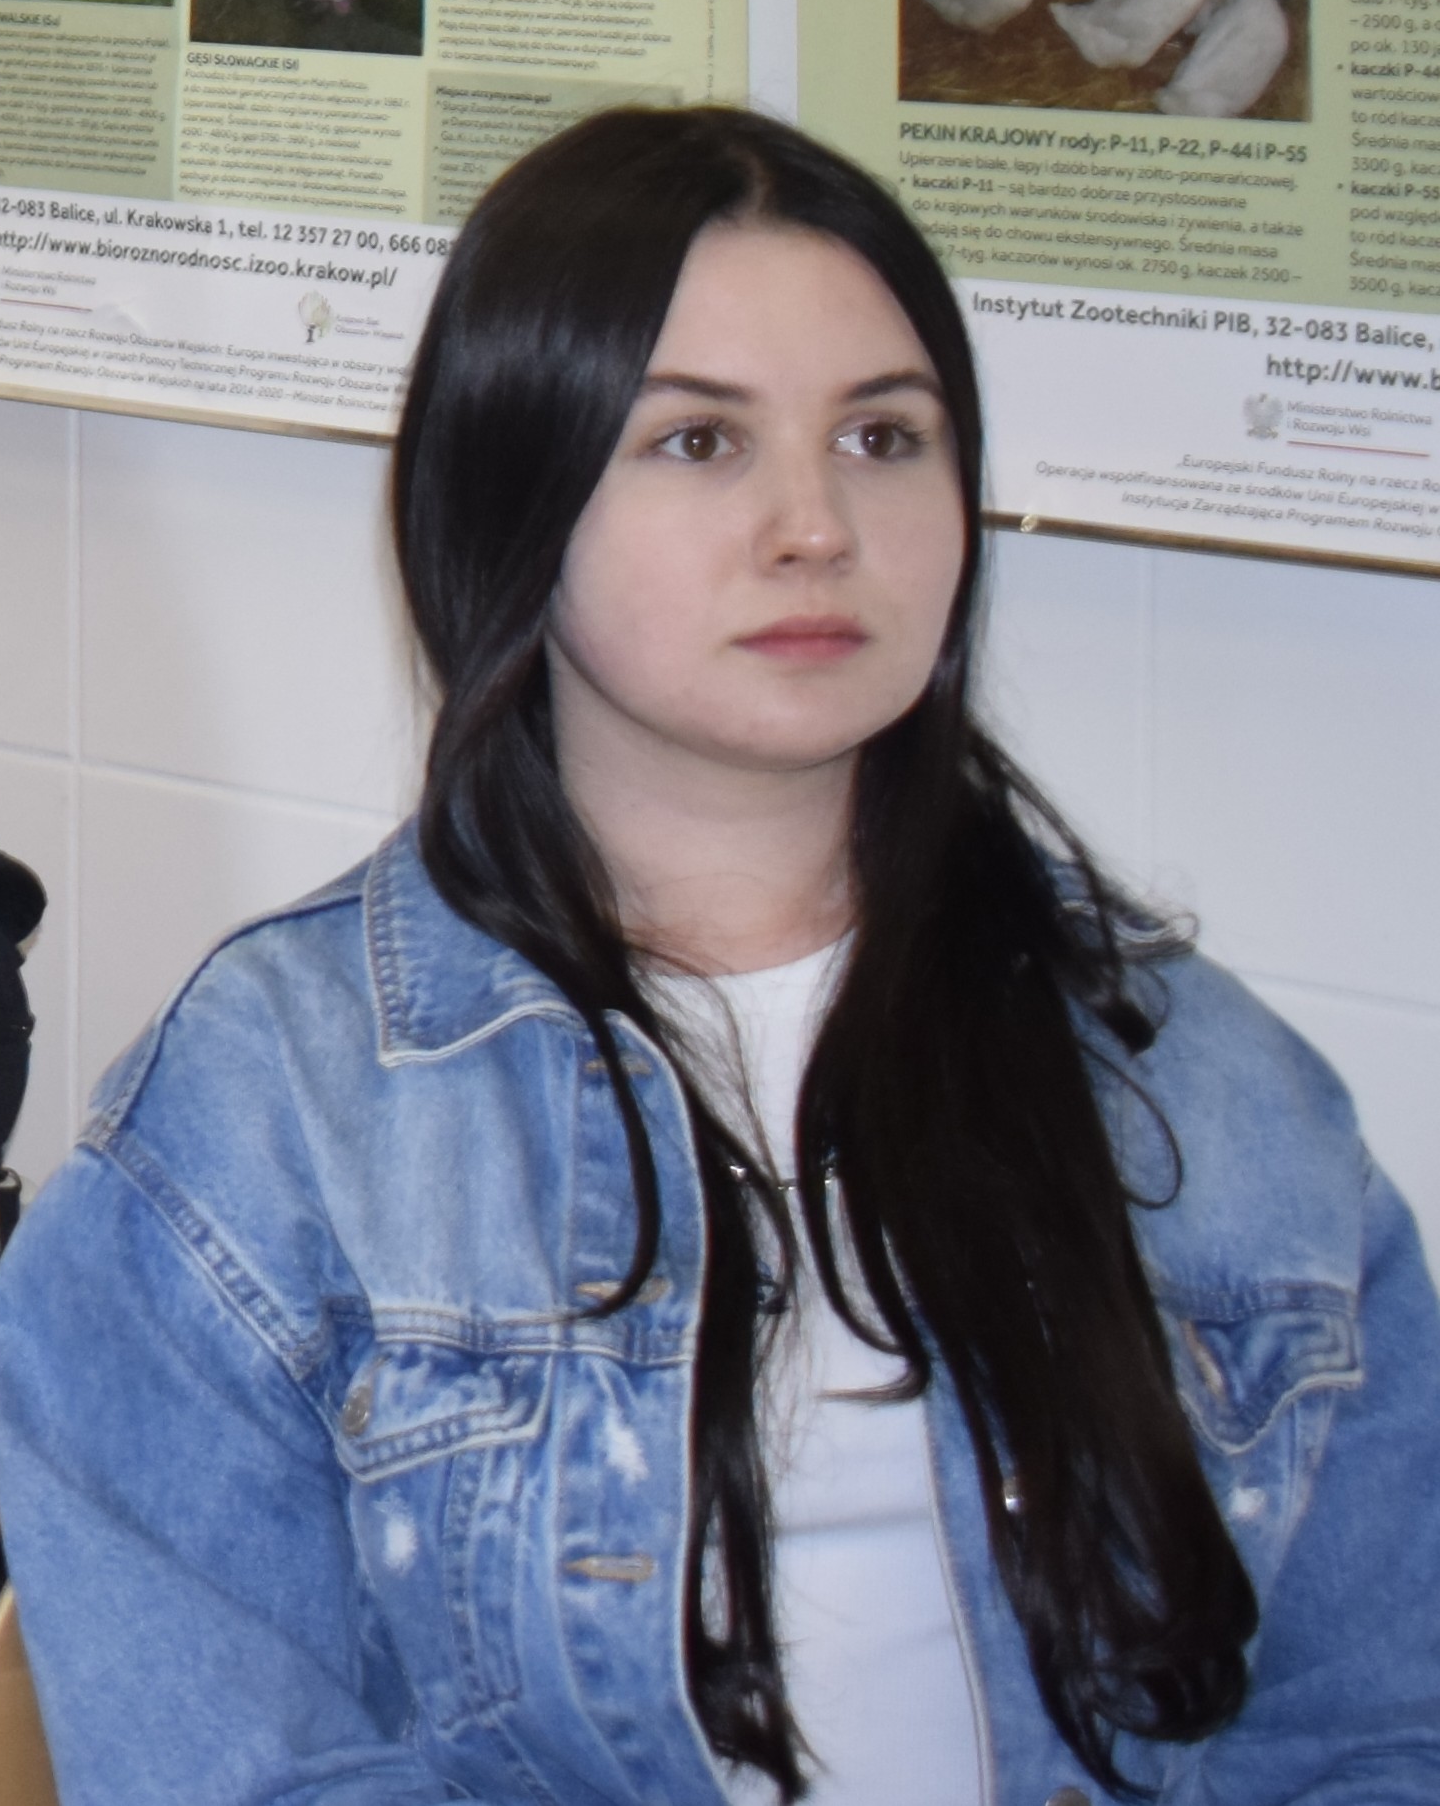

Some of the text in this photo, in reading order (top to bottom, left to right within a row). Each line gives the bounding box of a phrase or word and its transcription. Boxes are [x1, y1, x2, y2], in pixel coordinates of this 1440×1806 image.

[899, 122, 957, 143] PEKIN
[959, 125, 1055, 148] KRAJOWY
[1059, 131, 1107, 155] rody:
[1209, 139, 1251, 159] P-44
[1263, 142, 1307, 162] P-55
[49, 200, 101, 227] Balice,
[103, 206, 123, 226] ul.
[125, 207, 213, 234] Krakowska
[217, 216, 233, 239] 1,
[237, 218, 267, 239] tel.
[273, 221, 291, 241] 12
[297, 223, 329, 245] 357
[331, 226, 351, 247] 27
[355, 229, 383, 253] 00,
[389, 232, 421, 253] 666
[425, 235, 451, 255] 08
[971, 290, 1433, 355] Instytut Zootechniki PIB, 32-083 Balice,
